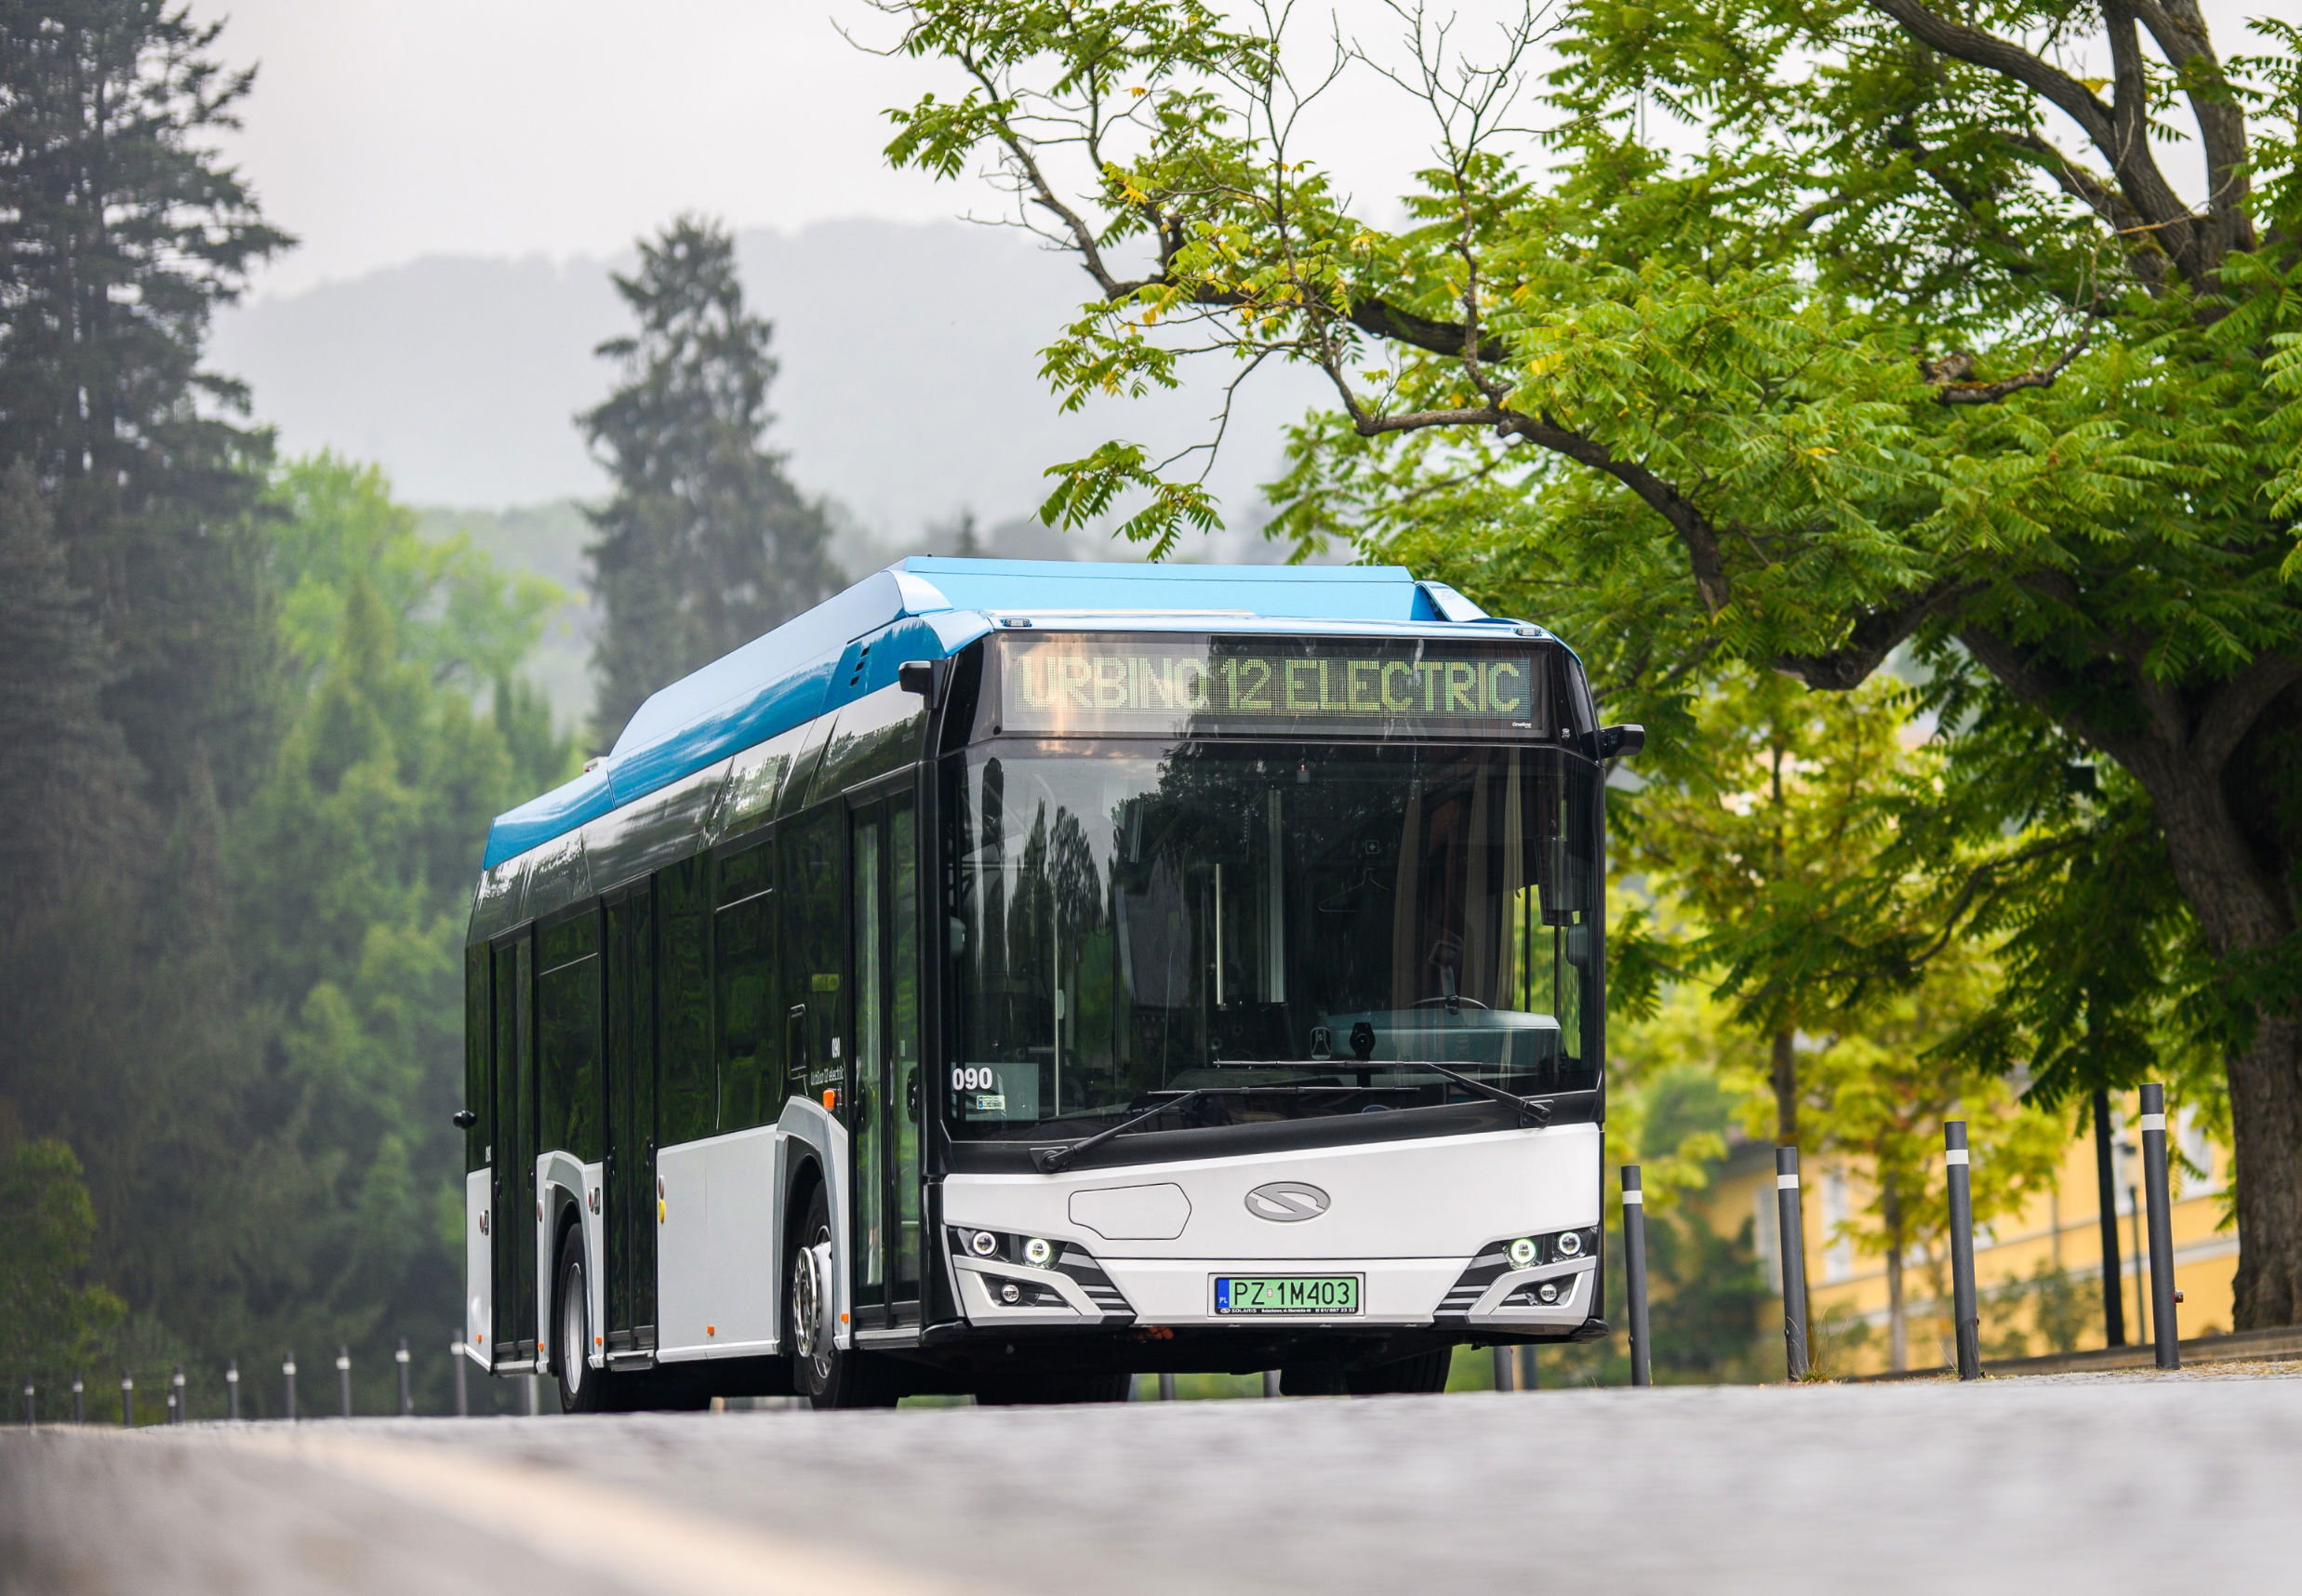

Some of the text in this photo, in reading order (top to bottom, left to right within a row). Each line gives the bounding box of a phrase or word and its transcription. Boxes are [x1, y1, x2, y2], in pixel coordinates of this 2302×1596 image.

[1019, 656, 1520, 712] URBINO 12 ELECTRIC
[952, 1068, 992, 1090] 090
[1234, 1282, 1350, 1305] PZ 1M403
